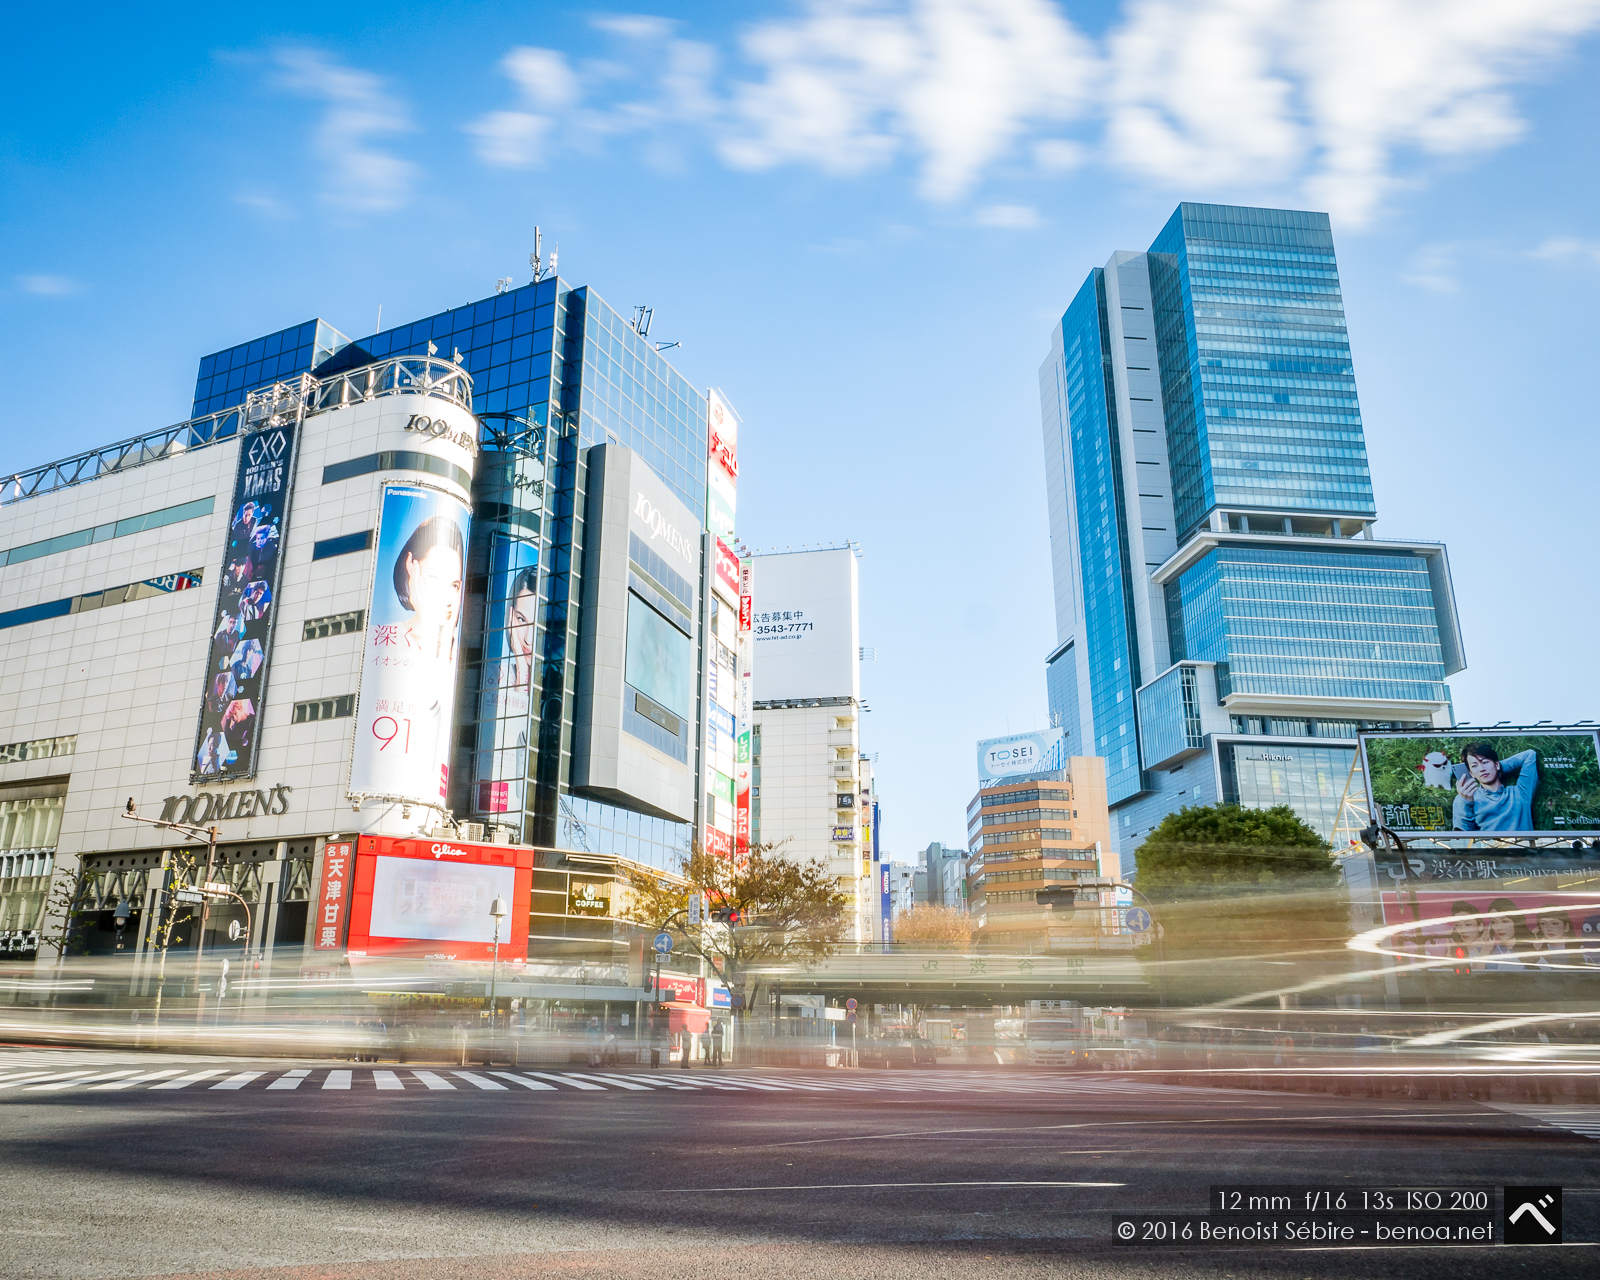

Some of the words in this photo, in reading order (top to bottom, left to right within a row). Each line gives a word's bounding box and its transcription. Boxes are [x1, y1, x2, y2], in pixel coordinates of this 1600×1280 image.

[248, 431, 287, 466] EXO
[243, 467, 283, 499] XMAS
[990, 746, 1033, 762] TOSEI
[738, 807, 747, 834] アコム
[431, 843, 468, 858] Glico
[1431, 859, 1499, 880] 渋谷駅
[320, 858, 345, 947] 天津甘栗
[575, 900, 604, 909] COFFEE
[922, 960, 939, 972] JR
